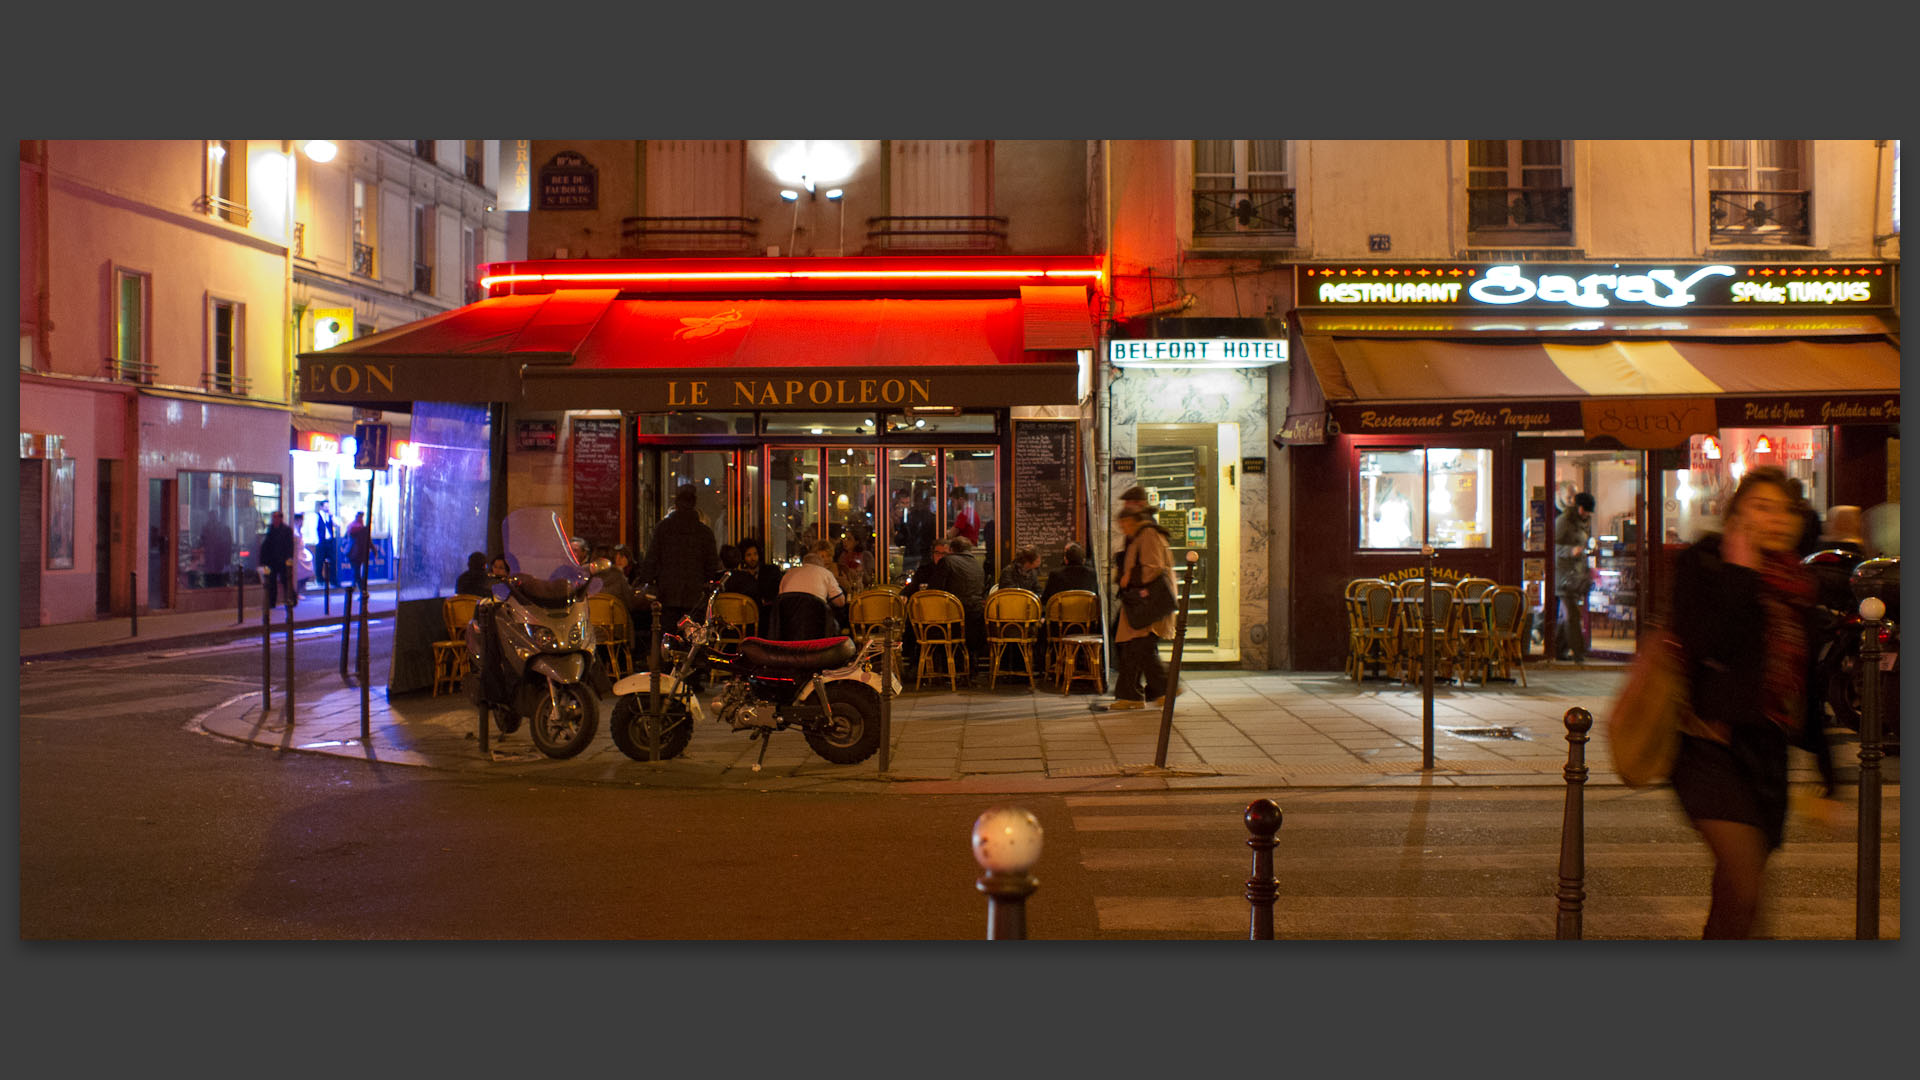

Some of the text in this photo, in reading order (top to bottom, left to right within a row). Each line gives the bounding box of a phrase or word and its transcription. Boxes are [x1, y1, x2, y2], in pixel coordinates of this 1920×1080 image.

[1319, 283, 1462, 302] RESTAURANT
[1787, 281, 1871, 304] TURQUES
[1115, 342, 1286, 359] BELFORT HOTEL
[666, 379, 931, 406] LE NAPOLEON
[1360, 410, 1443, 428] Restaurant
[1745, 402, 1769, 420] Plat
[1821, 401, 1867, 422] Grillades
[1433, 567, 1477, 582] HALA
